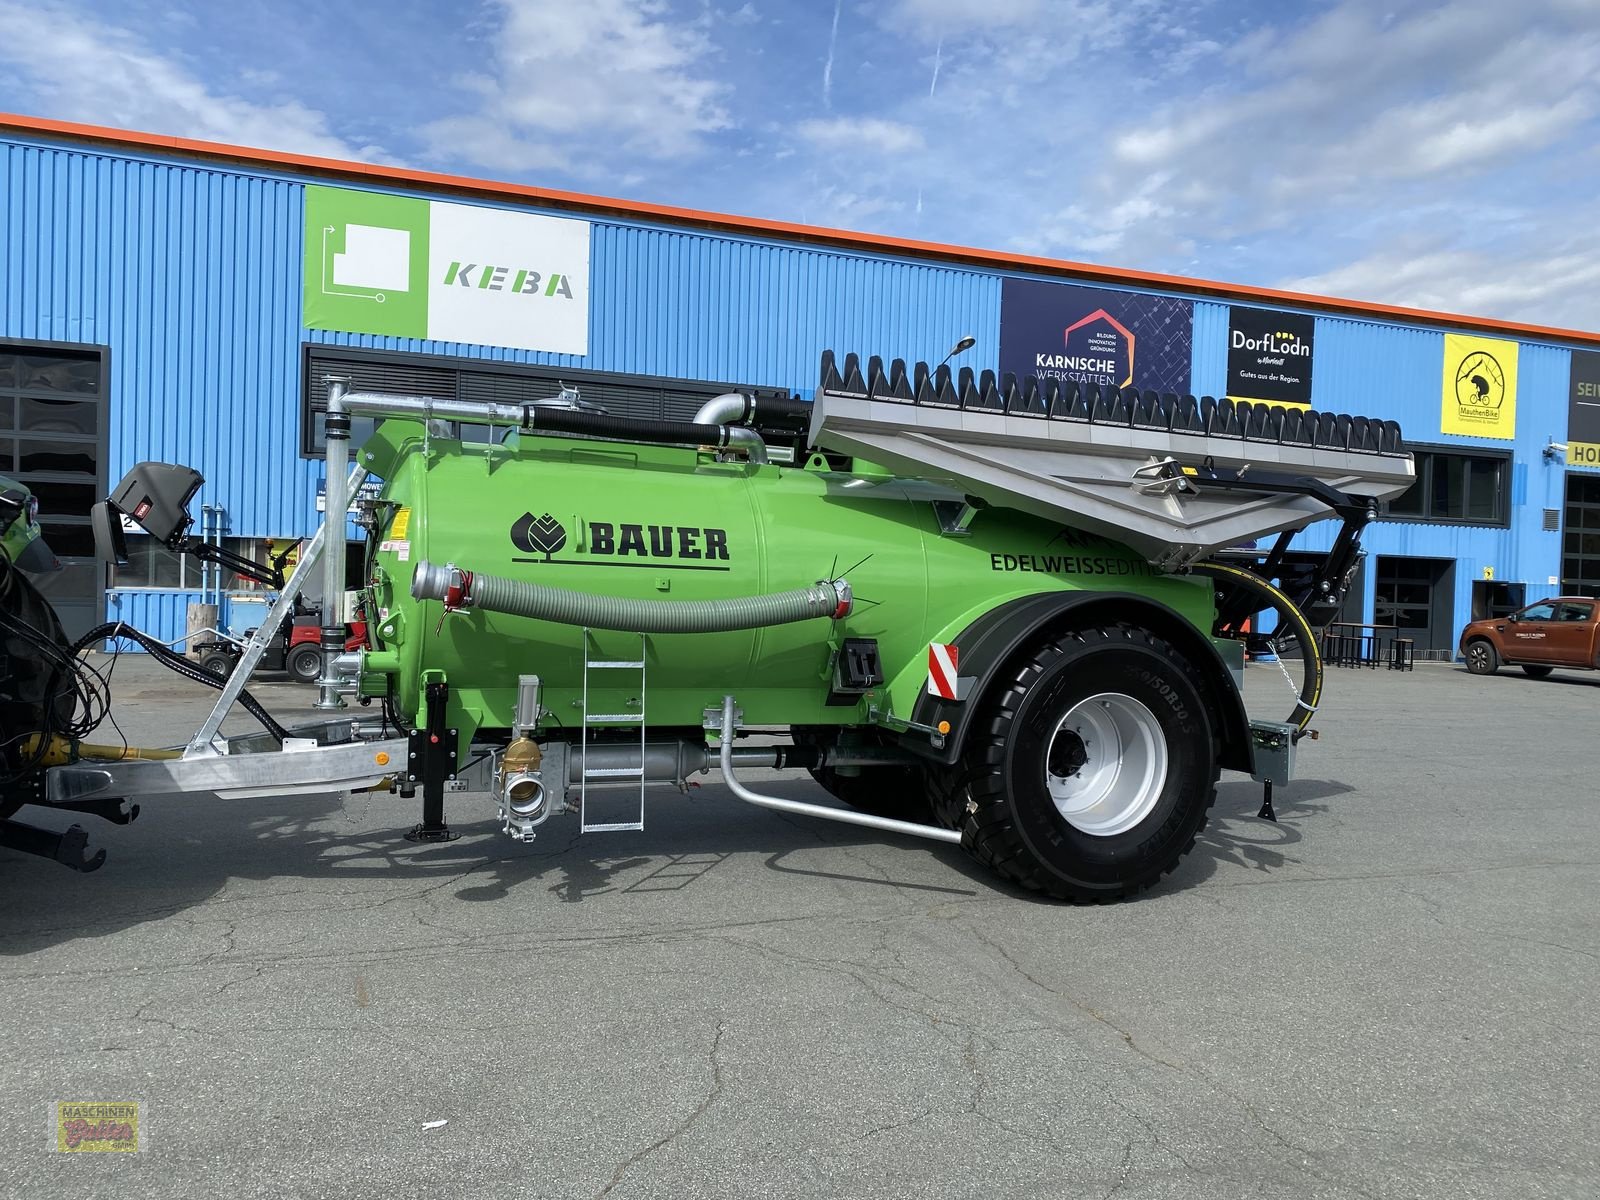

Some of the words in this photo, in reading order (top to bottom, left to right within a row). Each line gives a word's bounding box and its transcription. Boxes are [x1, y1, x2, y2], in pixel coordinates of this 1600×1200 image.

[443, 261, 574, 300] KEBA
[1087, 338, 1117, 347] INNOVATION
[1096, 332, 1117, 340] BILDUNG
[1036, 353, 1116, 373] KARNISCHE
[1036, 369, 1116, 386] WERKSTÄTTEN
[1239, 369, 1257, 379] Gutes
[1268, 372, 1279, 381] der
[123, 516, 133, 528] 2
[589, 522, 730, 560] BAUER
